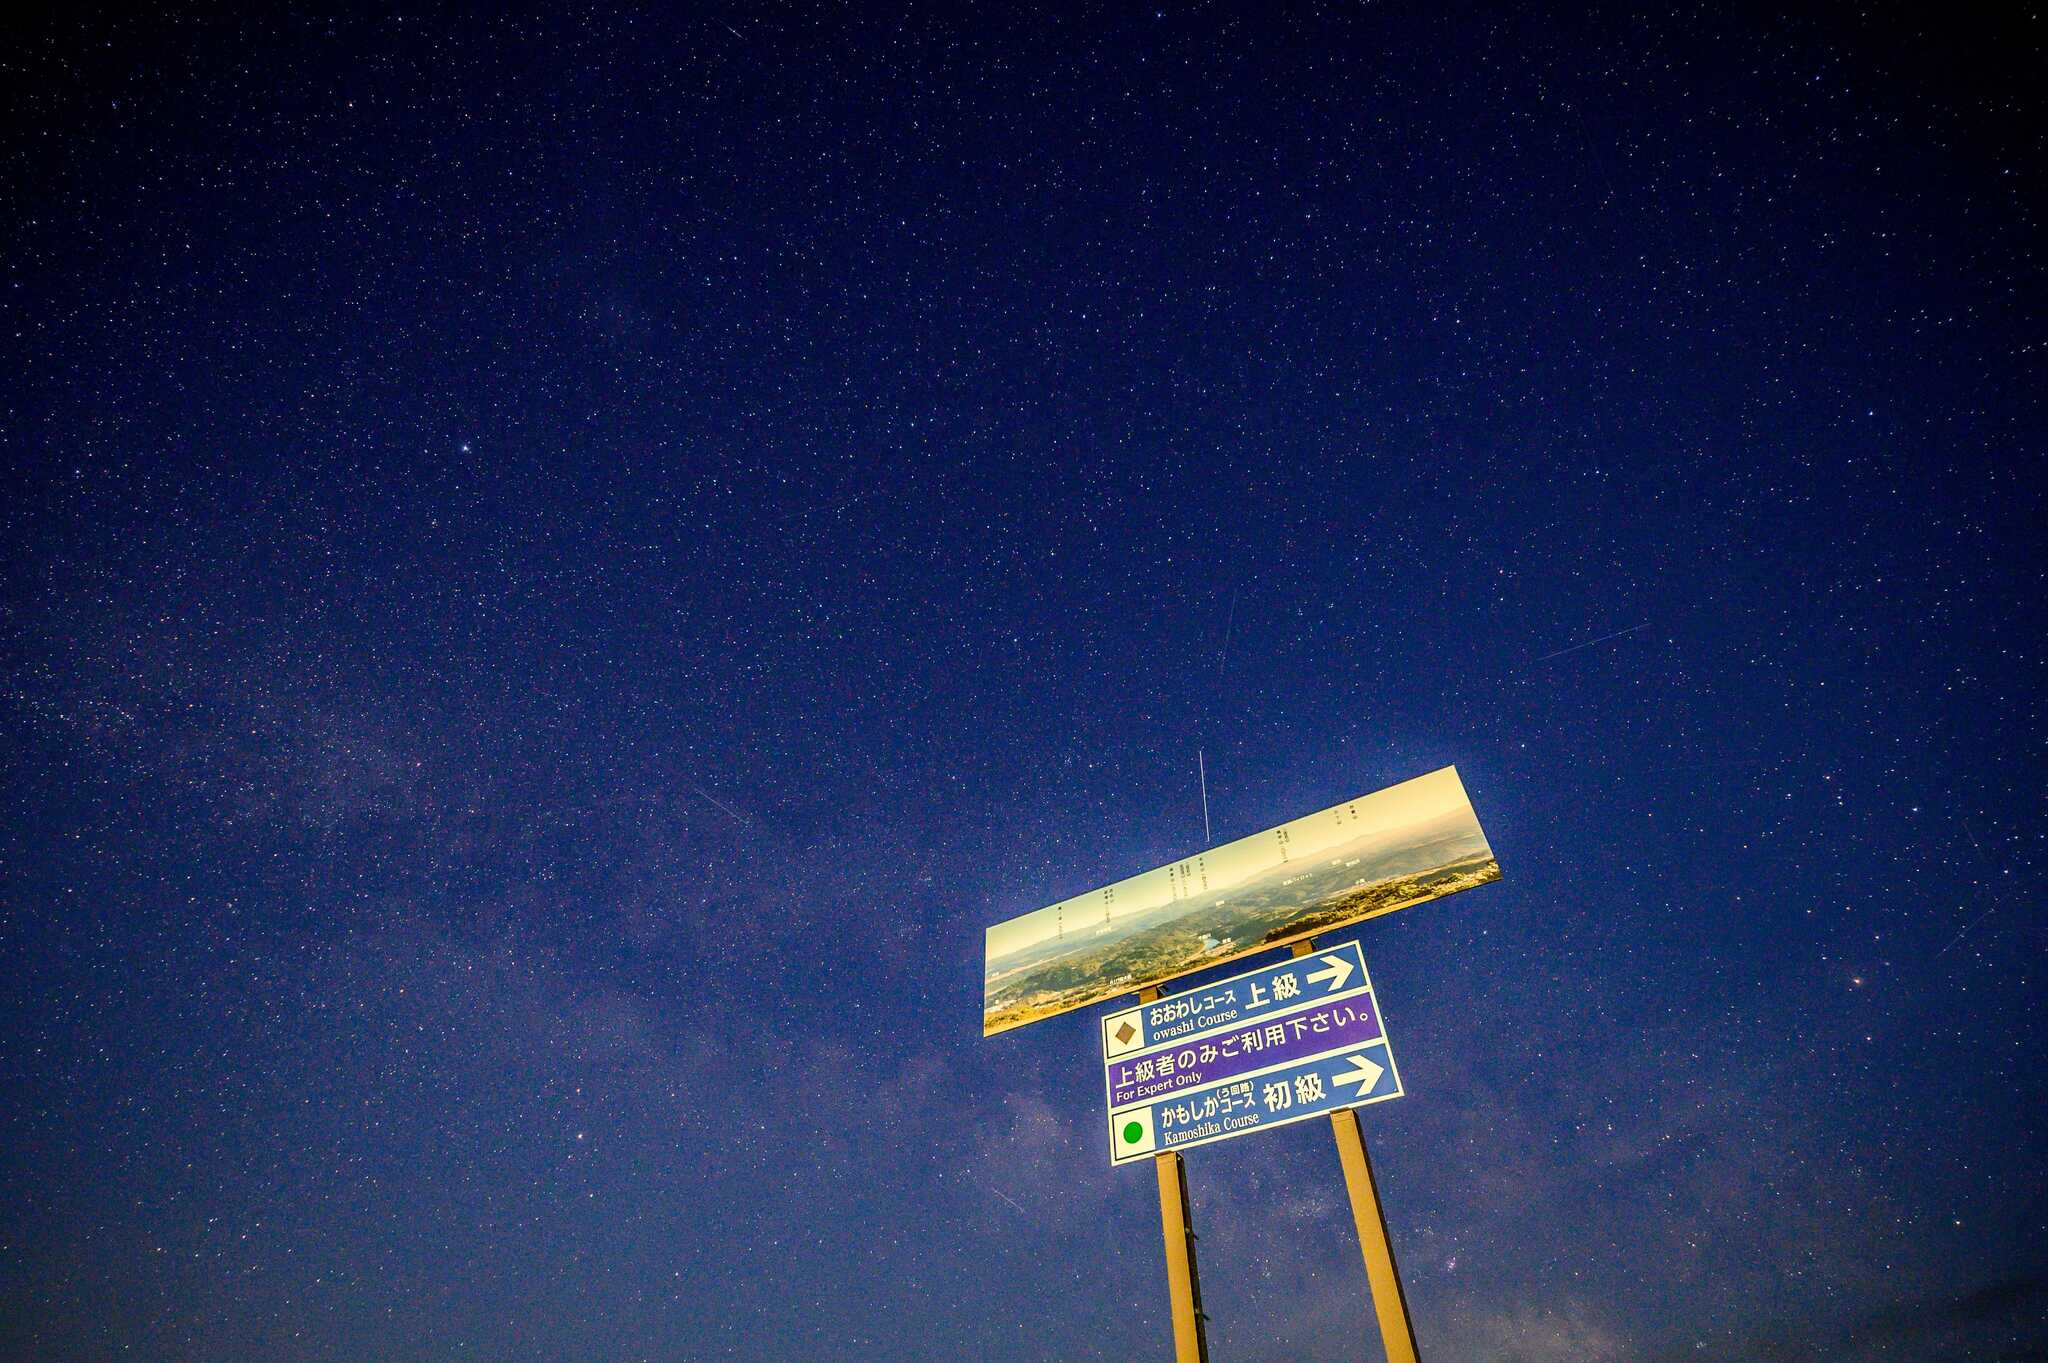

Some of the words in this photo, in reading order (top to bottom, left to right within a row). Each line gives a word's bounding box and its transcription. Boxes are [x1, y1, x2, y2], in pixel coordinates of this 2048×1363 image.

[1149, 989, 1236, 1026] おおわしコース
[1244, 972, 1301, 1010] 上級
[1197, 1009, 1238, 1028] Course
[1115, 1006, 1368, 1089] 上級者のみご利用下さい。
[1116, 1089, 1135, 1102] For
[1137, 1079, 1173, 1097] Expert
[1176, 1071, 1202, 1085] Only
[1161, 1093, 1256, 1129] かもしかコース
[1264, 1073, 1327, 1112] 初級
[1164, 1122, 1221, 1146] Kamoshika
[1223, 1113, 1260, 1130] Course
